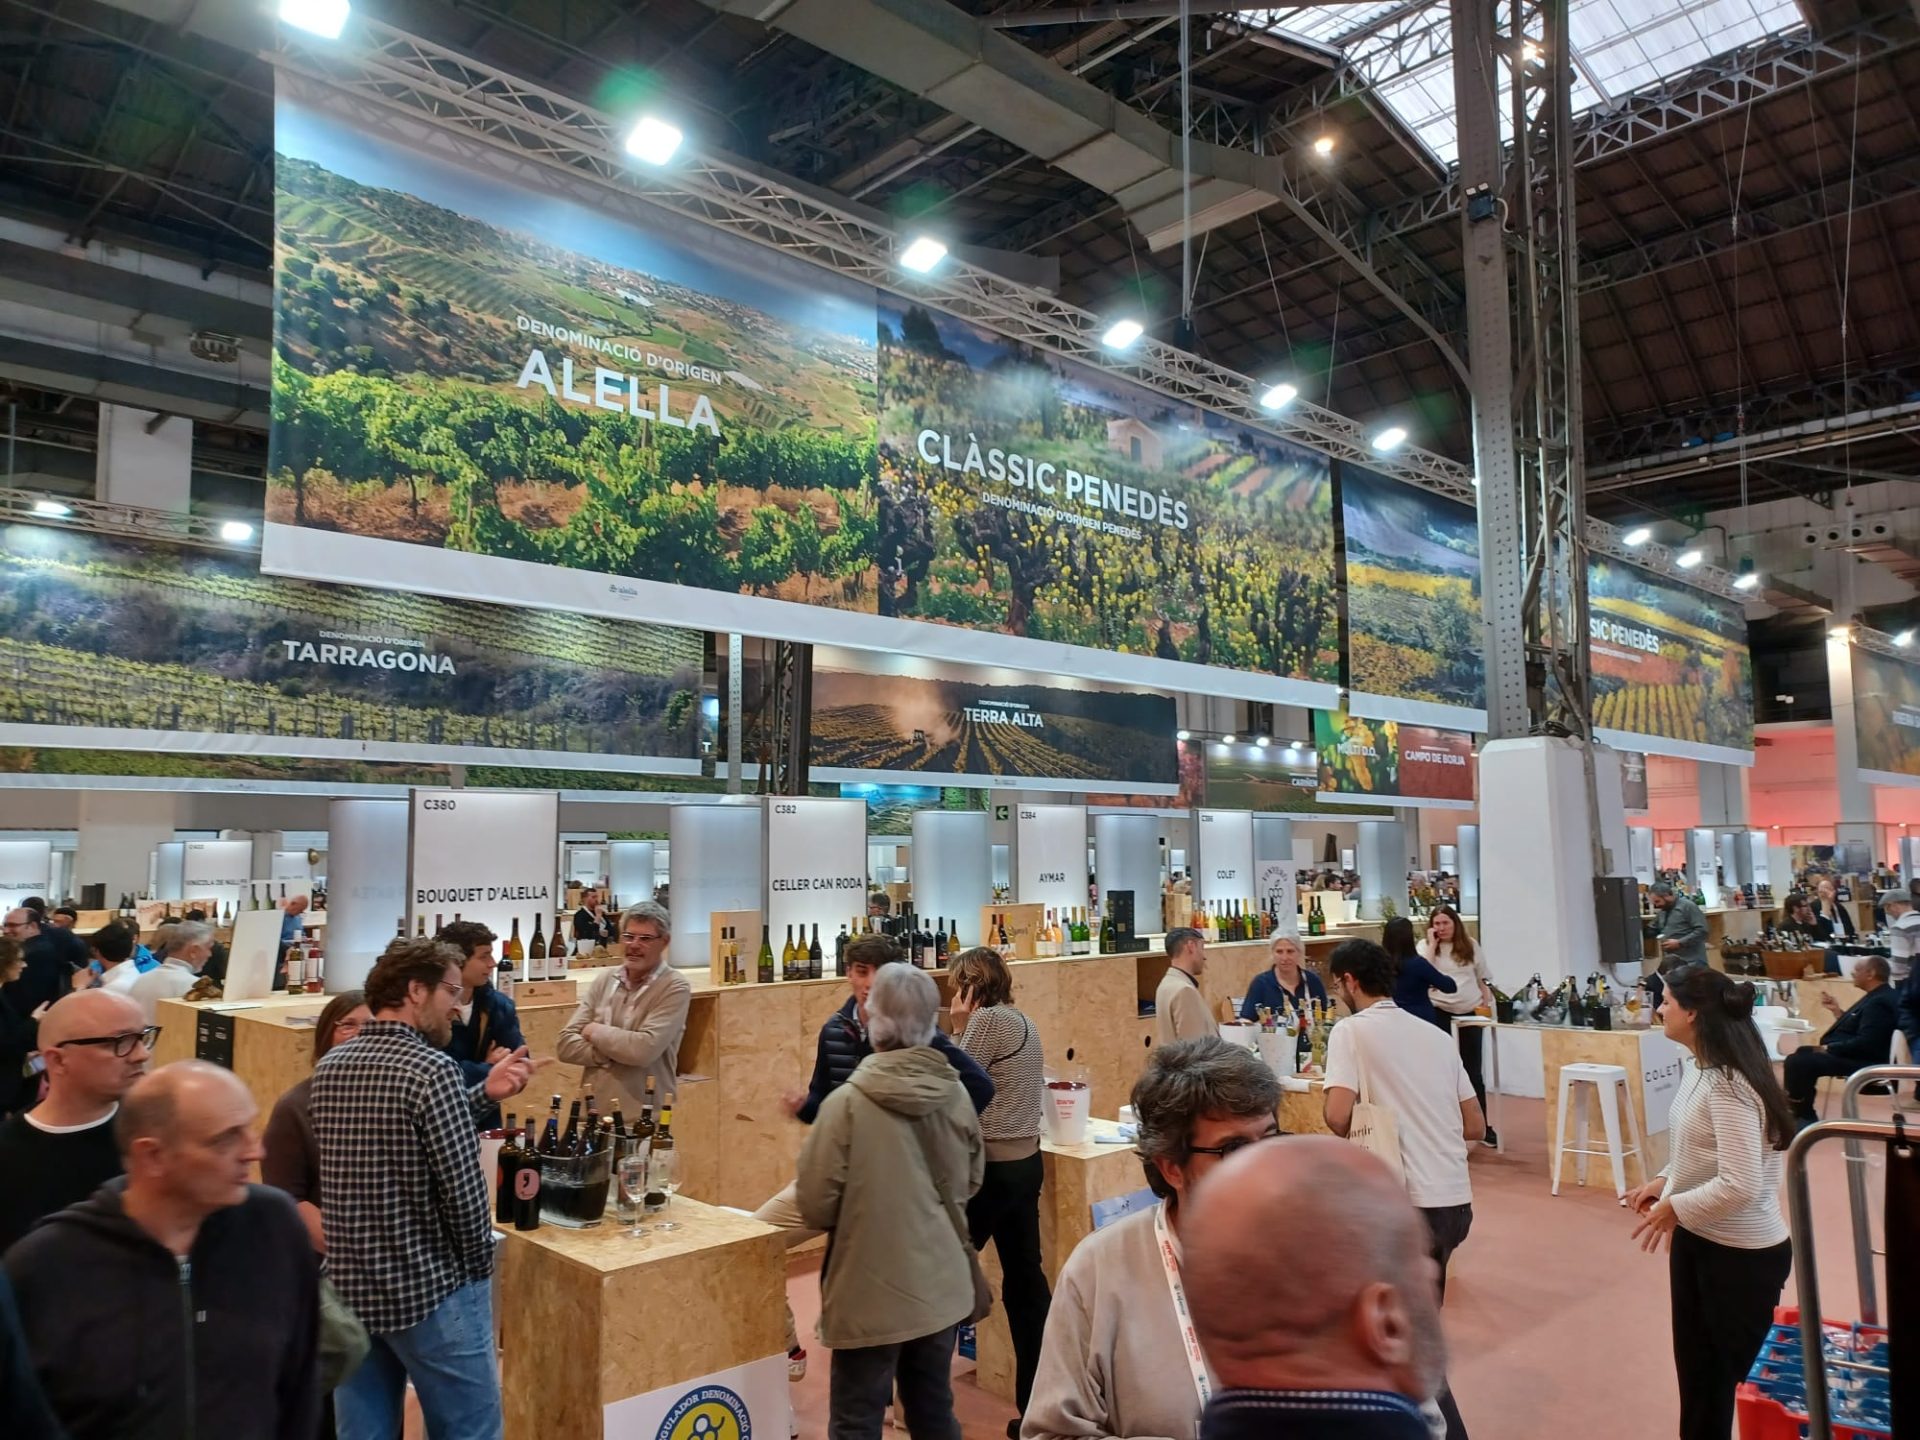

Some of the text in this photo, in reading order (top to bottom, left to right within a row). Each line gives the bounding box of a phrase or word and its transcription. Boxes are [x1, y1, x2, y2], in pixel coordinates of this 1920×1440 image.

[516, 315, 722, 385] DENOMINACIÓ D'ORIGEN
[516, 349, 720, 437] ALELLA
[917, 429, 1189, 529] CLÀSSIC PENEDÈS
[982, 491, 1142, 540] DENOMINACIÓ D'ORIGEN PENEDÈS
[1611, 623, 1659, 654] PENEDÈS
[282, 639, 456, 676] TARRAGONA
[963, 707, 1044, 728] TERRA ALTA
[1404, 750, 1466, 766] CAMPO DE BORJA
[424, 799, 456, 811] C380
[775, 804, 797, 814] C382
[772, 879, 810, 892] CELLER
[812, 878, 833, 890] CAN
[835, 877, 863, 890] RODA
[1039, 872, 1065, 882] AYMAR
[1217, 870, 1236, 879] COLET
[417, 887, 484, 904] BOUQUET
[488, 885, 549, 901] D'ALELLA
[1645, 1064, 1677, 1082] COLET
[659, 1389, 750, 1440] GULADOR DENOMINACIÓ
